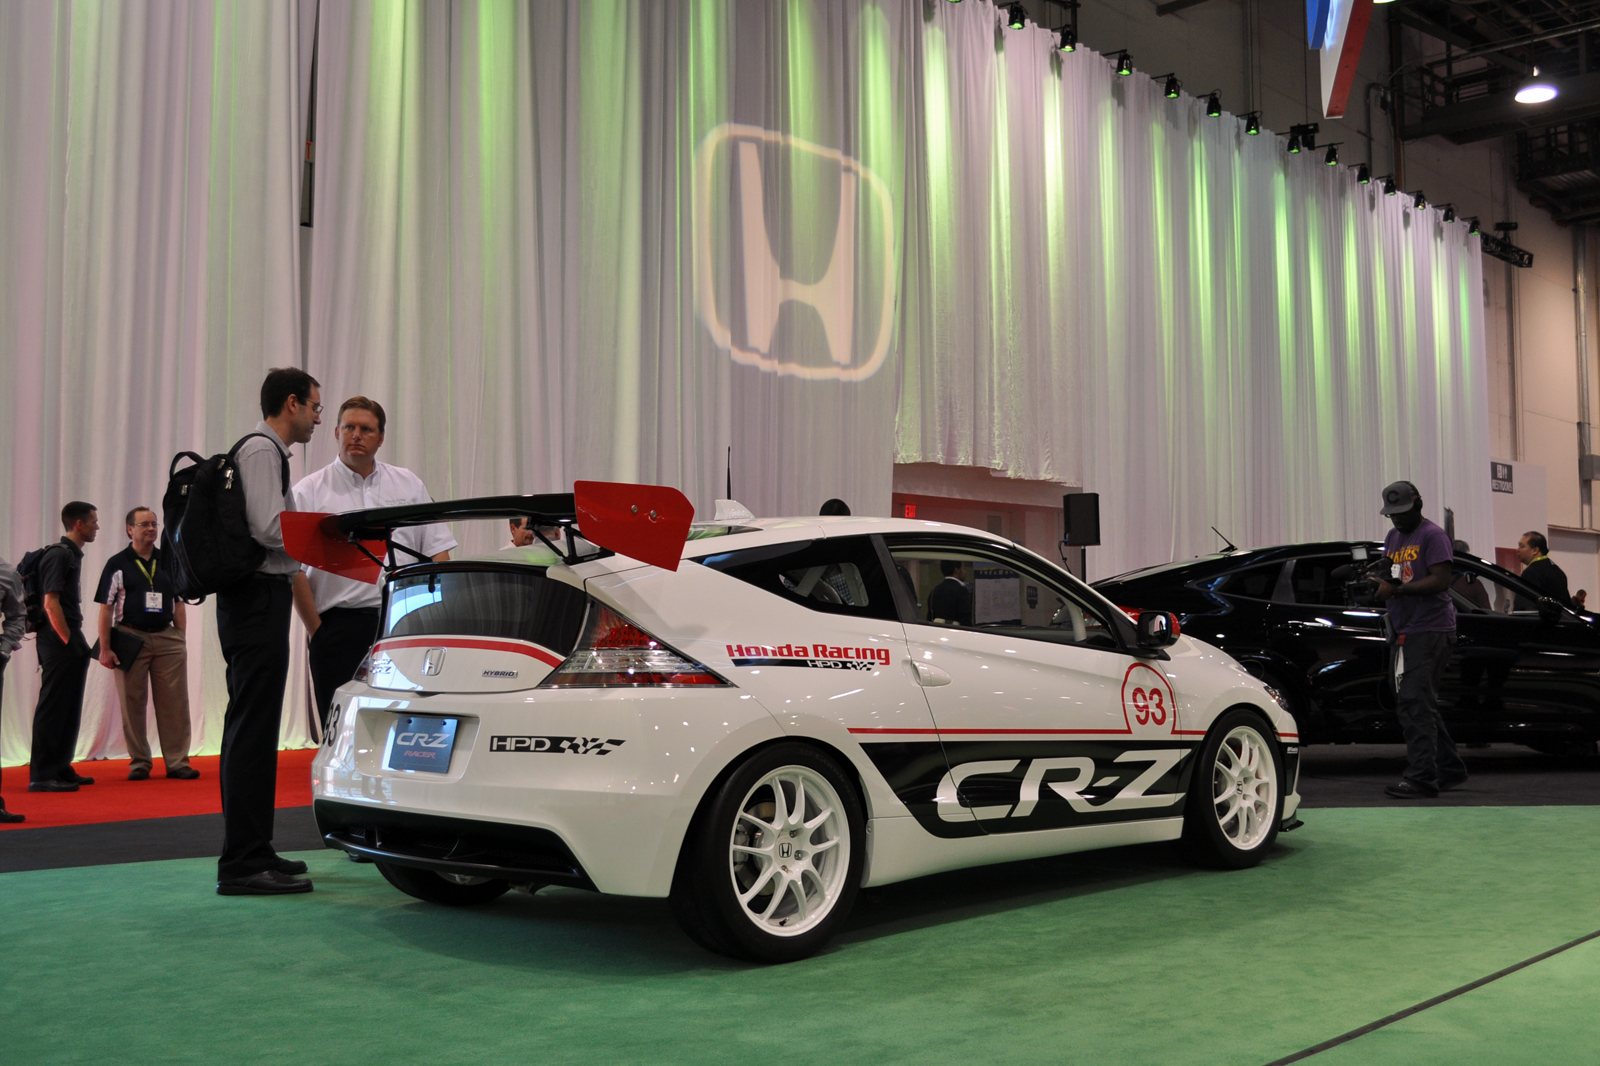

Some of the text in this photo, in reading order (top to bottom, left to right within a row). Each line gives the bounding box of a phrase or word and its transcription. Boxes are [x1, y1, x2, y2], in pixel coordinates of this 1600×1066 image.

[905, 504, 916, 518] EXIT
[726, 644, 890, 665] Honda Racing
[806, 660, 842, 669] HPD
[1132, 687, 1167, 726] 93
[396, 732, 451, 748] CR-Z
[492, 737, 551, 751] HPD
[404, 750, 436, 759] RACER
[936, 749, 1192, 823] CR-Z
